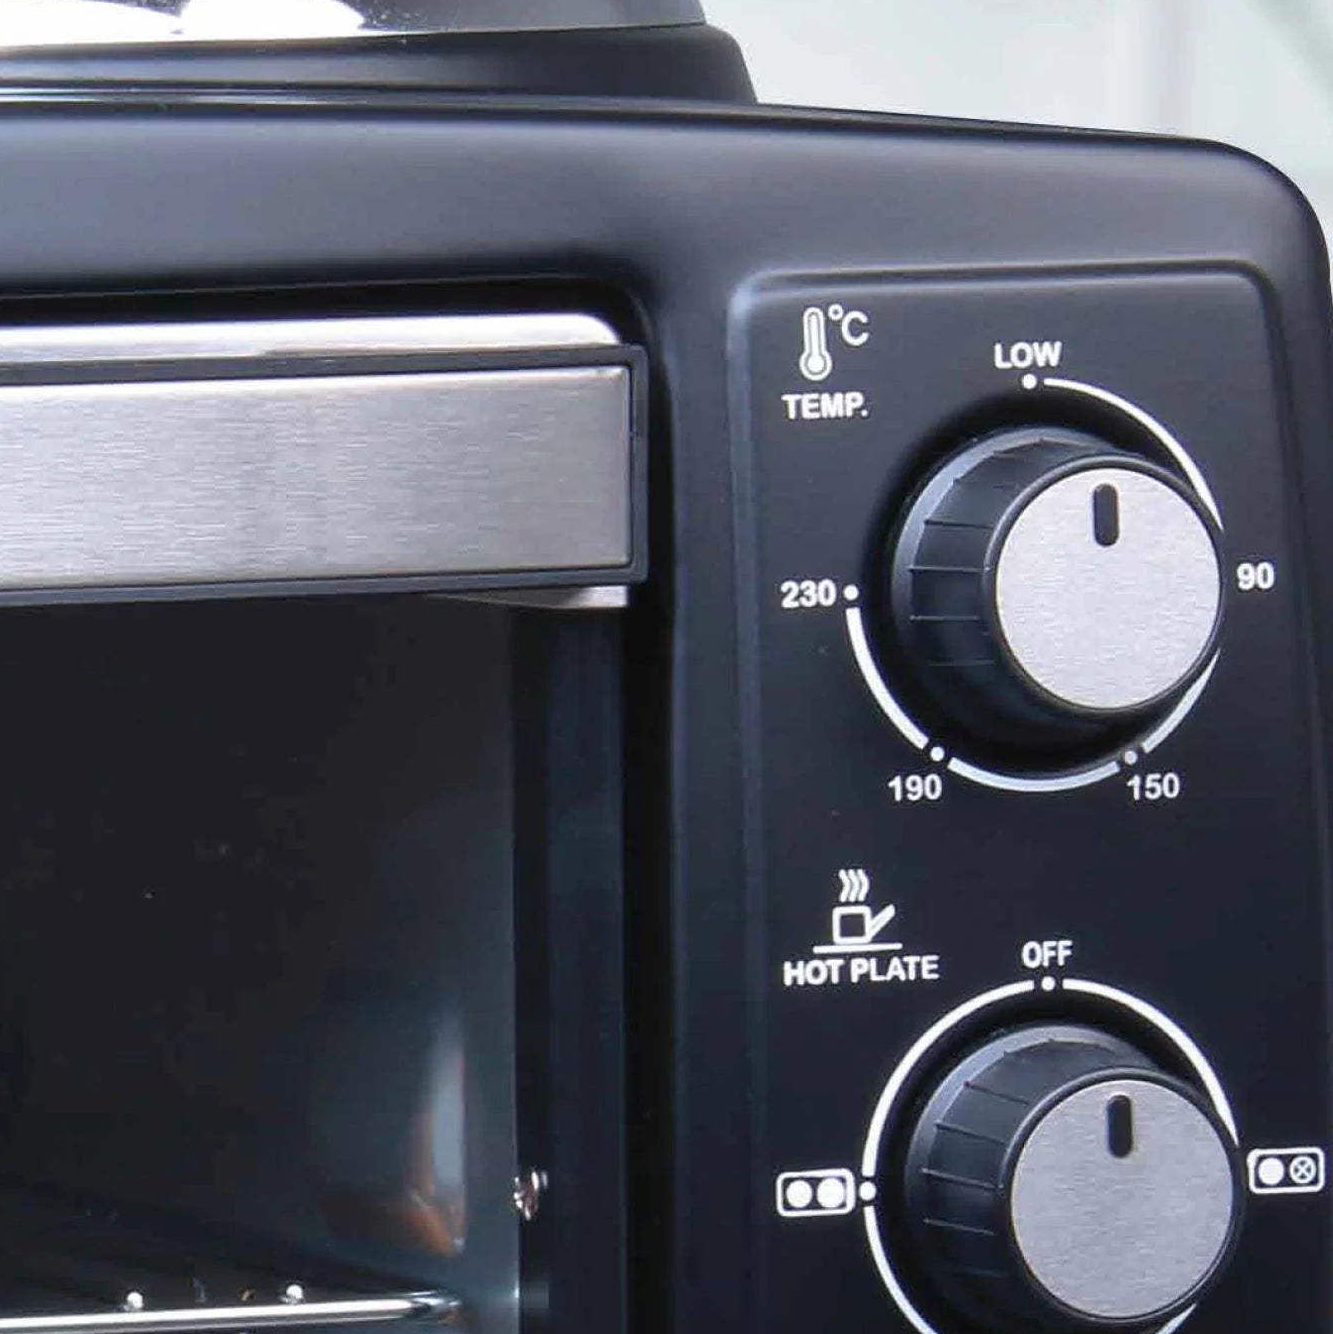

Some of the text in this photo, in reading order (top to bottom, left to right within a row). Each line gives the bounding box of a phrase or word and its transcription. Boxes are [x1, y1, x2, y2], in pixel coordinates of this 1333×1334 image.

[994, 340, 1062, 369] LOW
[780, 391, 869, 420] TEMP.
[1236, 561, 1275, 591] 90
[780, 578, 836, 609] 230
[887, 773, 943, 802] 190
[1126, 772, 1180, 801] 150
[1021, 939, 1073, 969] OFF
[783, 954, 940, 987] HOT PLATE
